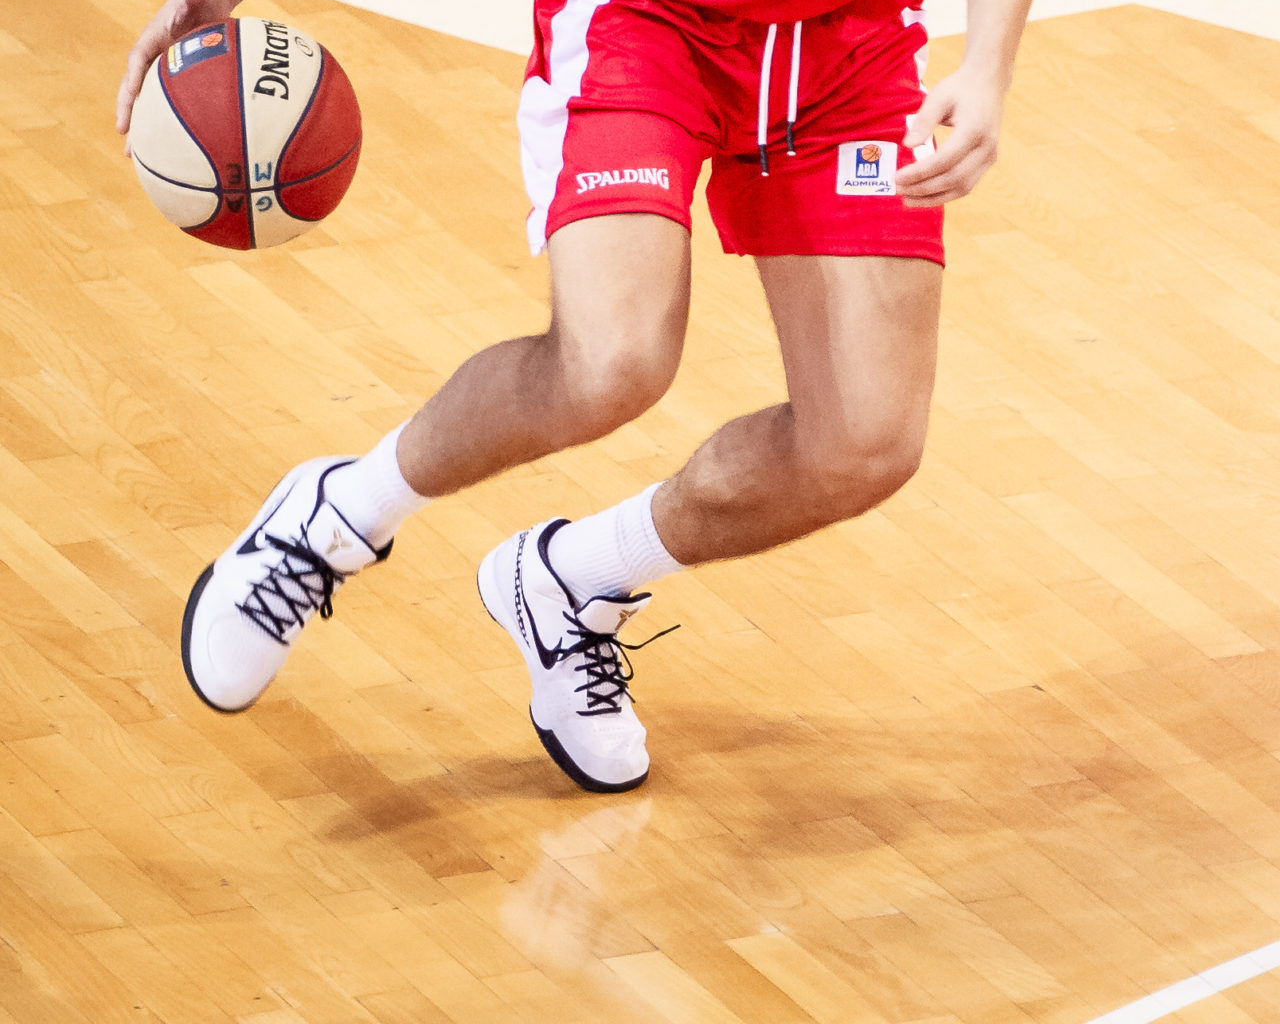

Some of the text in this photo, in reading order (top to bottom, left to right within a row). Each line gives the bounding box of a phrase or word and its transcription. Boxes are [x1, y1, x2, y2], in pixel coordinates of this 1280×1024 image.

[857, 163, 878, 177] ABA
[575, 167, 669, 195] SPALDING
[844, 179, 891, 187] ADMIRAL
